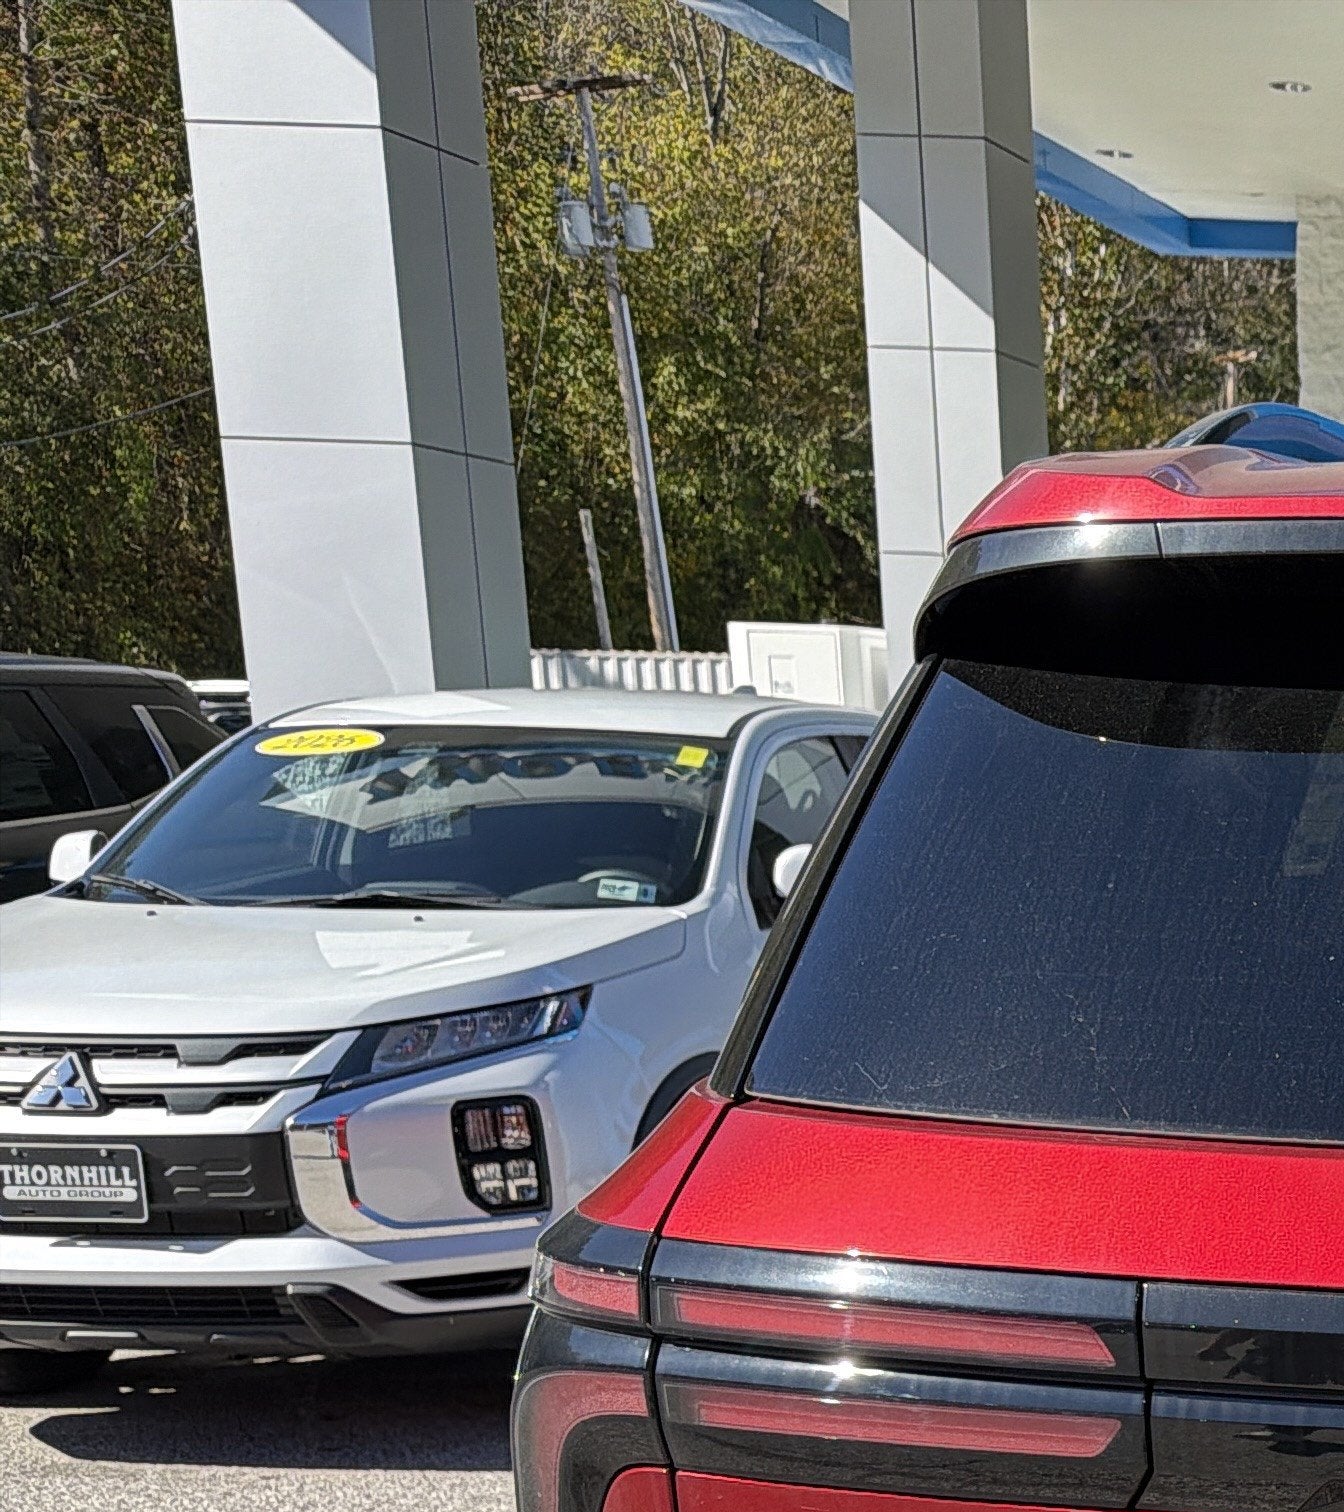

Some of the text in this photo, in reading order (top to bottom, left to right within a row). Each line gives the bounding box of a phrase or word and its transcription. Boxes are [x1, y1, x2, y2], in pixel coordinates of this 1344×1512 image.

[0, 1164, 138, 1187] THORNHILL
[17, 1188, 124, 1198] AUTO GROUP
